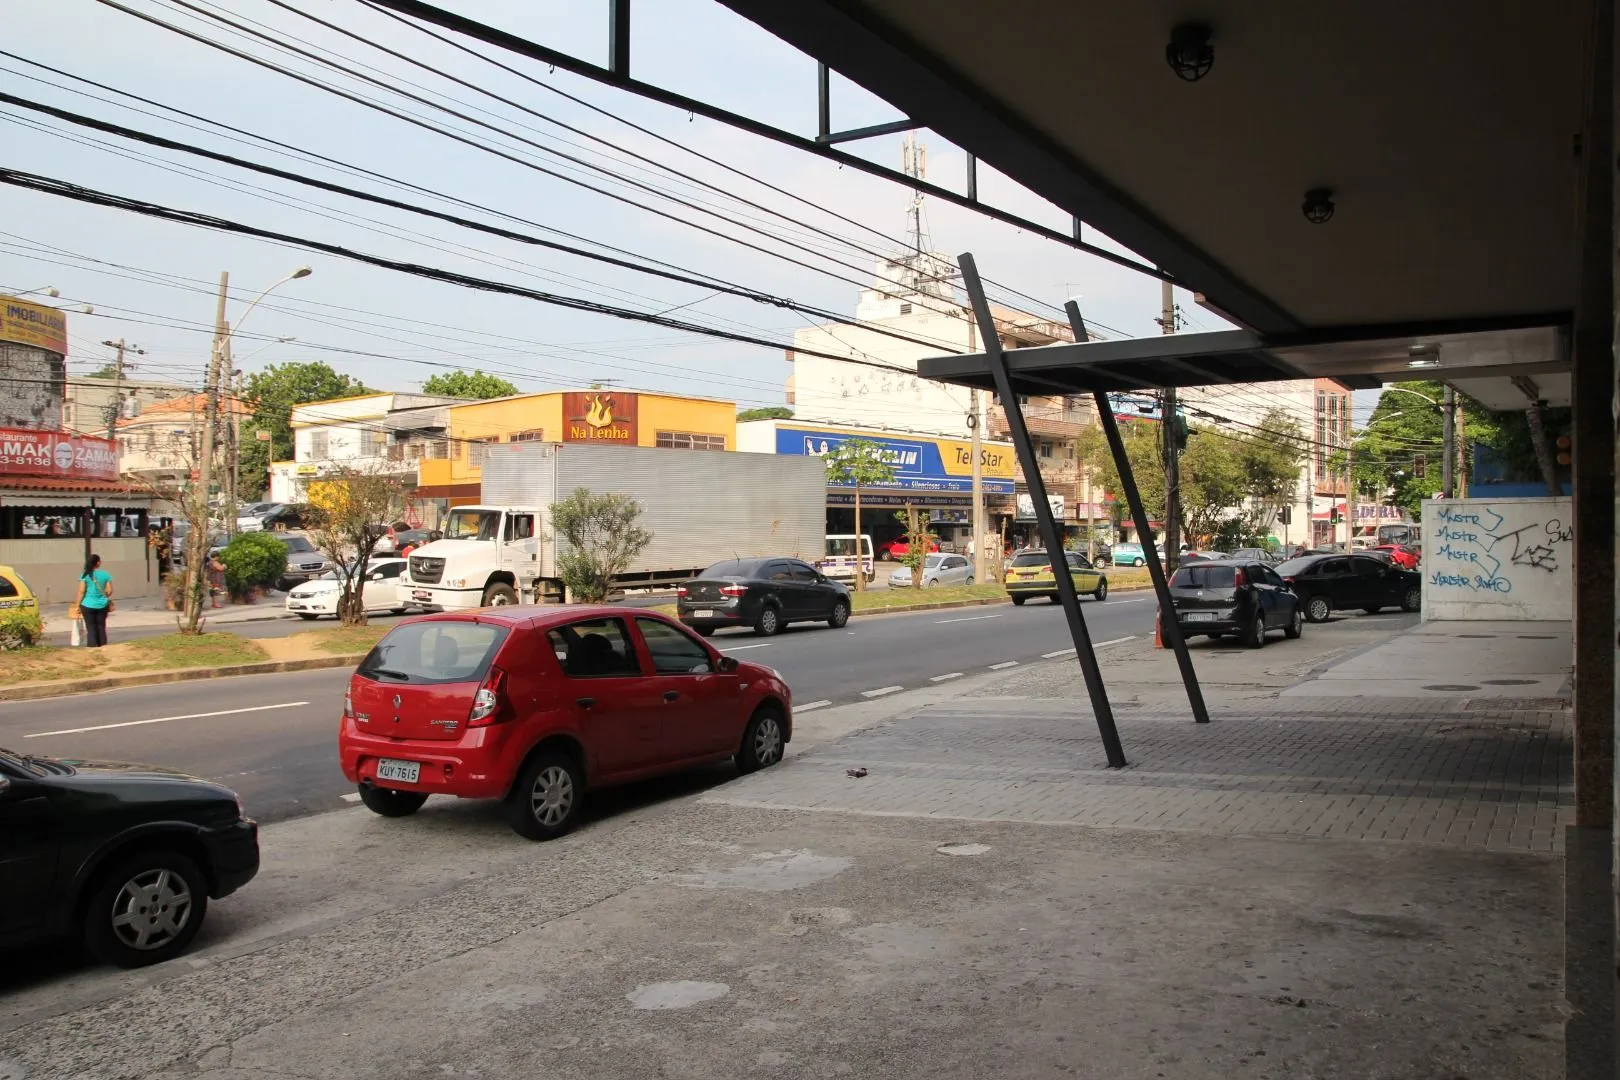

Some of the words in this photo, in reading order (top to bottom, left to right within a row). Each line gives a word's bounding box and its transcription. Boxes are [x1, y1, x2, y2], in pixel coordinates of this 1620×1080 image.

[571, 426, 586, 439] Na
[589, 425, 629, 439] Lenha
[0, 442, 51, 458] MAK
[837, 446, 918, 465] CHELIN
[980, 450, 1003, 467] Star
[379, 765, 395, 777] KUY
[397, 767, 417, 780] 7615
